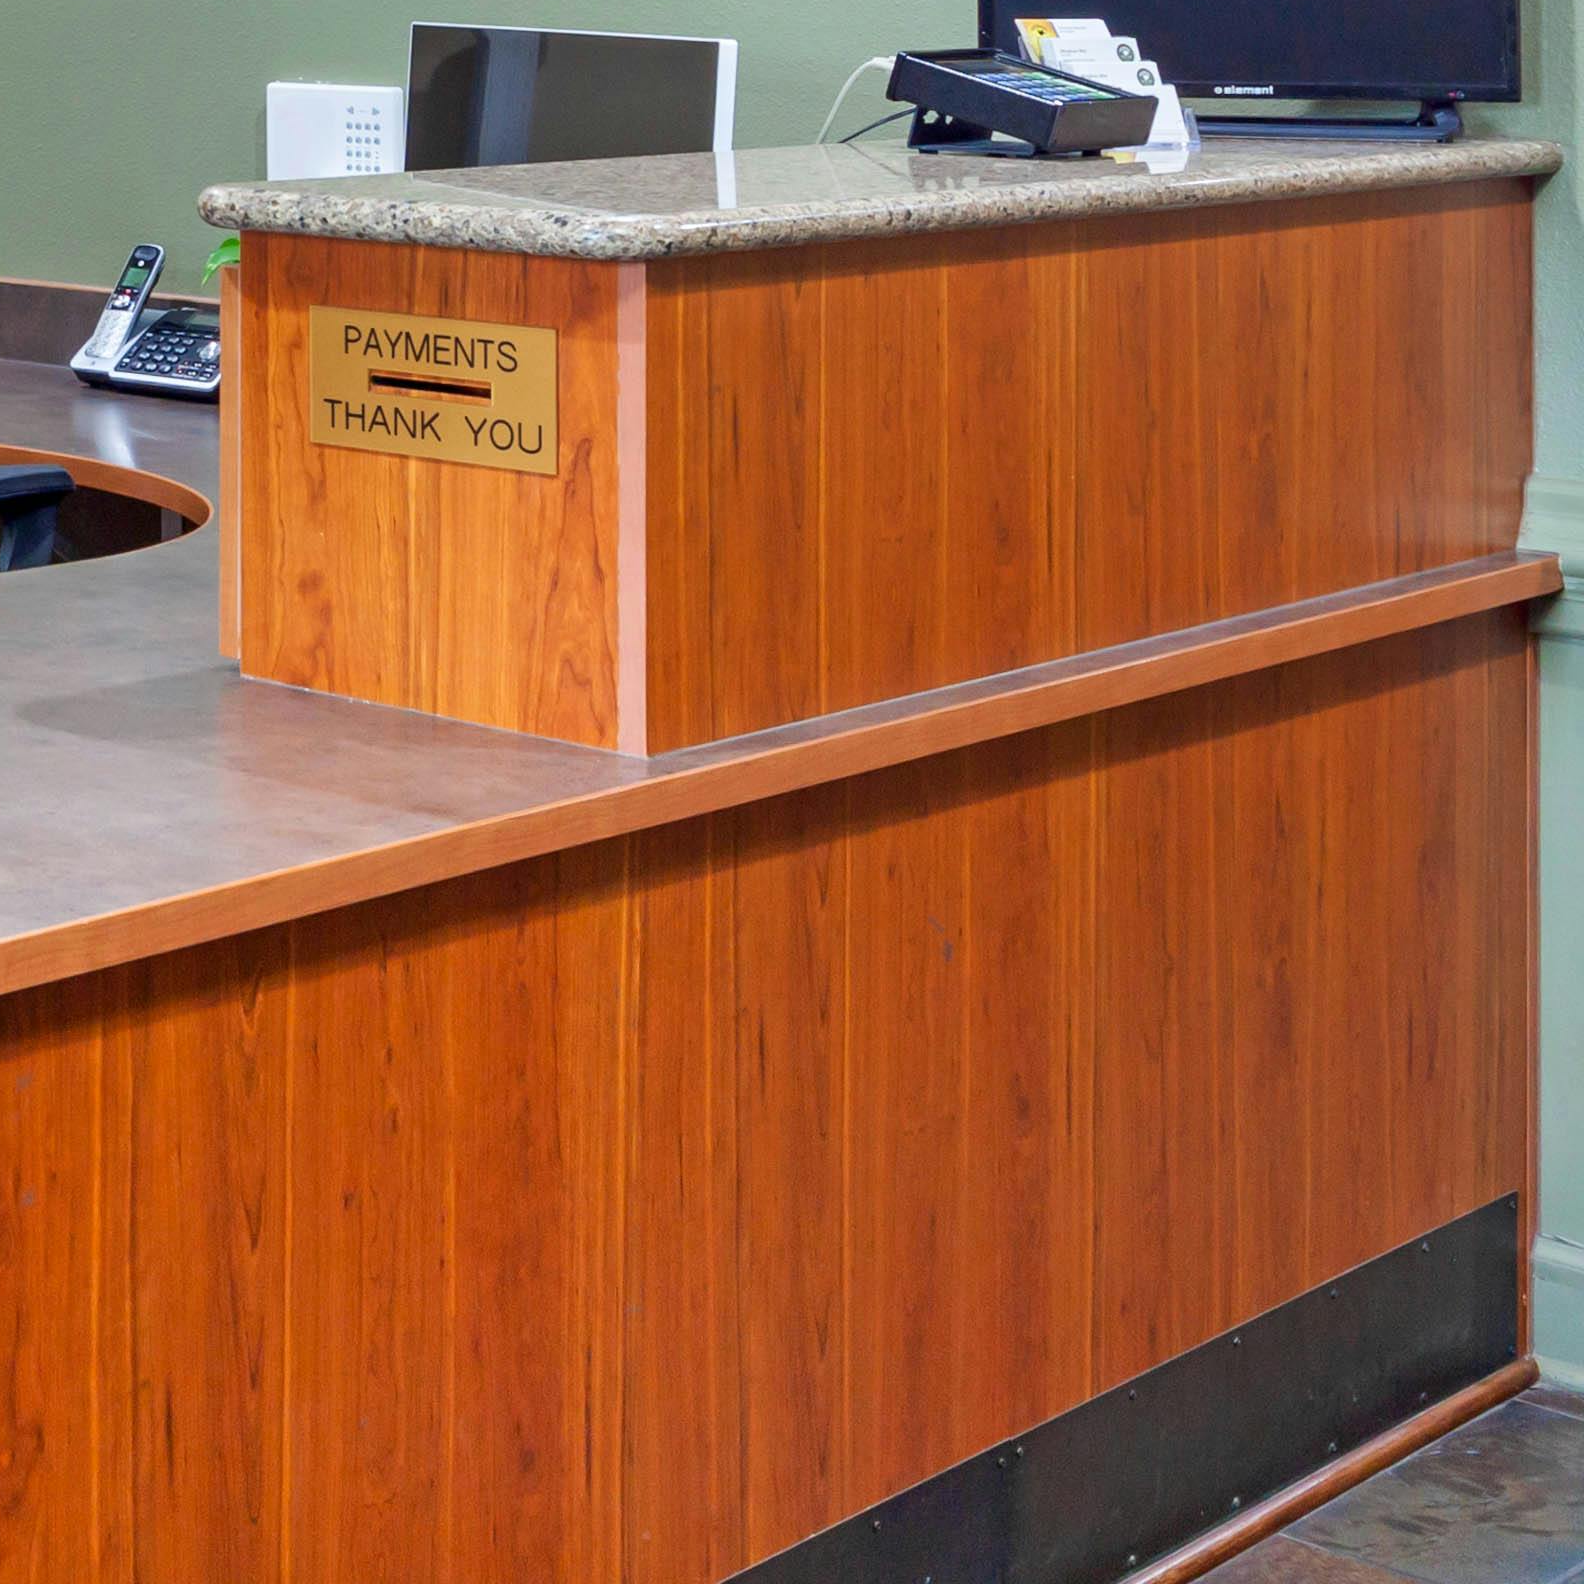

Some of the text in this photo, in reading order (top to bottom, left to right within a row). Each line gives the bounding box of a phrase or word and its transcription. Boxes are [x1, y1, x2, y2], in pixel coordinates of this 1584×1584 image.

[1223, 84, 1274, 96] element
[343, 324, 520, 374] PAYMENTS
[322, 397, 544, 455] THANK YOU
